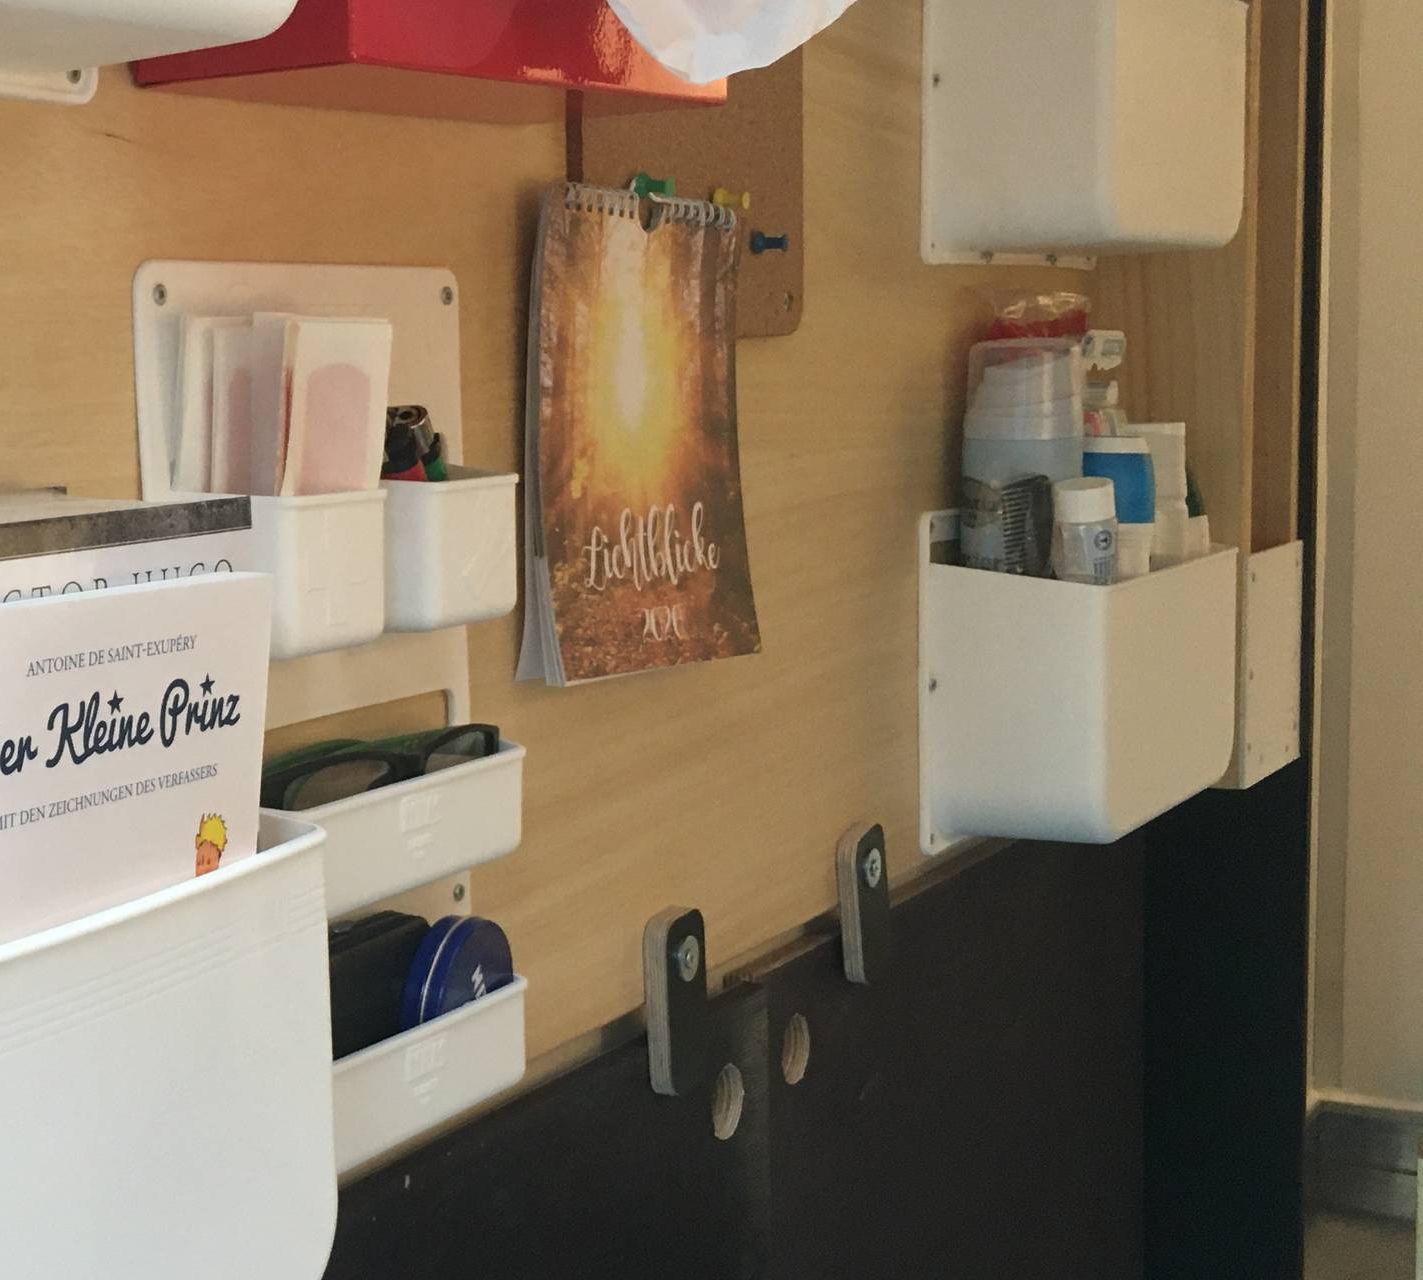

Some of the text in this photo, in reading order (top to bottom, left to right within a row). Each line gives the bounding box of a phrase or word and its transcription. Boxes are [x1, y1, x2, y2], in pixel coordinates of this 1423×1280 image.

[582, 501, 721, 592] Lichtblicke
[26, 634, 198, 678] ANTOINE DE SAINT-EXUPÉRY
[45, 689, 154, 769] Kleine
[159, 672, 241, 748] Prinz
[19, 805, 46, 825] DEN
[48, 783, 133, 817] ZEICHNUNGEN
[135, 777, 157, 797] DES
[158, 763, 219, 791] VERFASSERS
